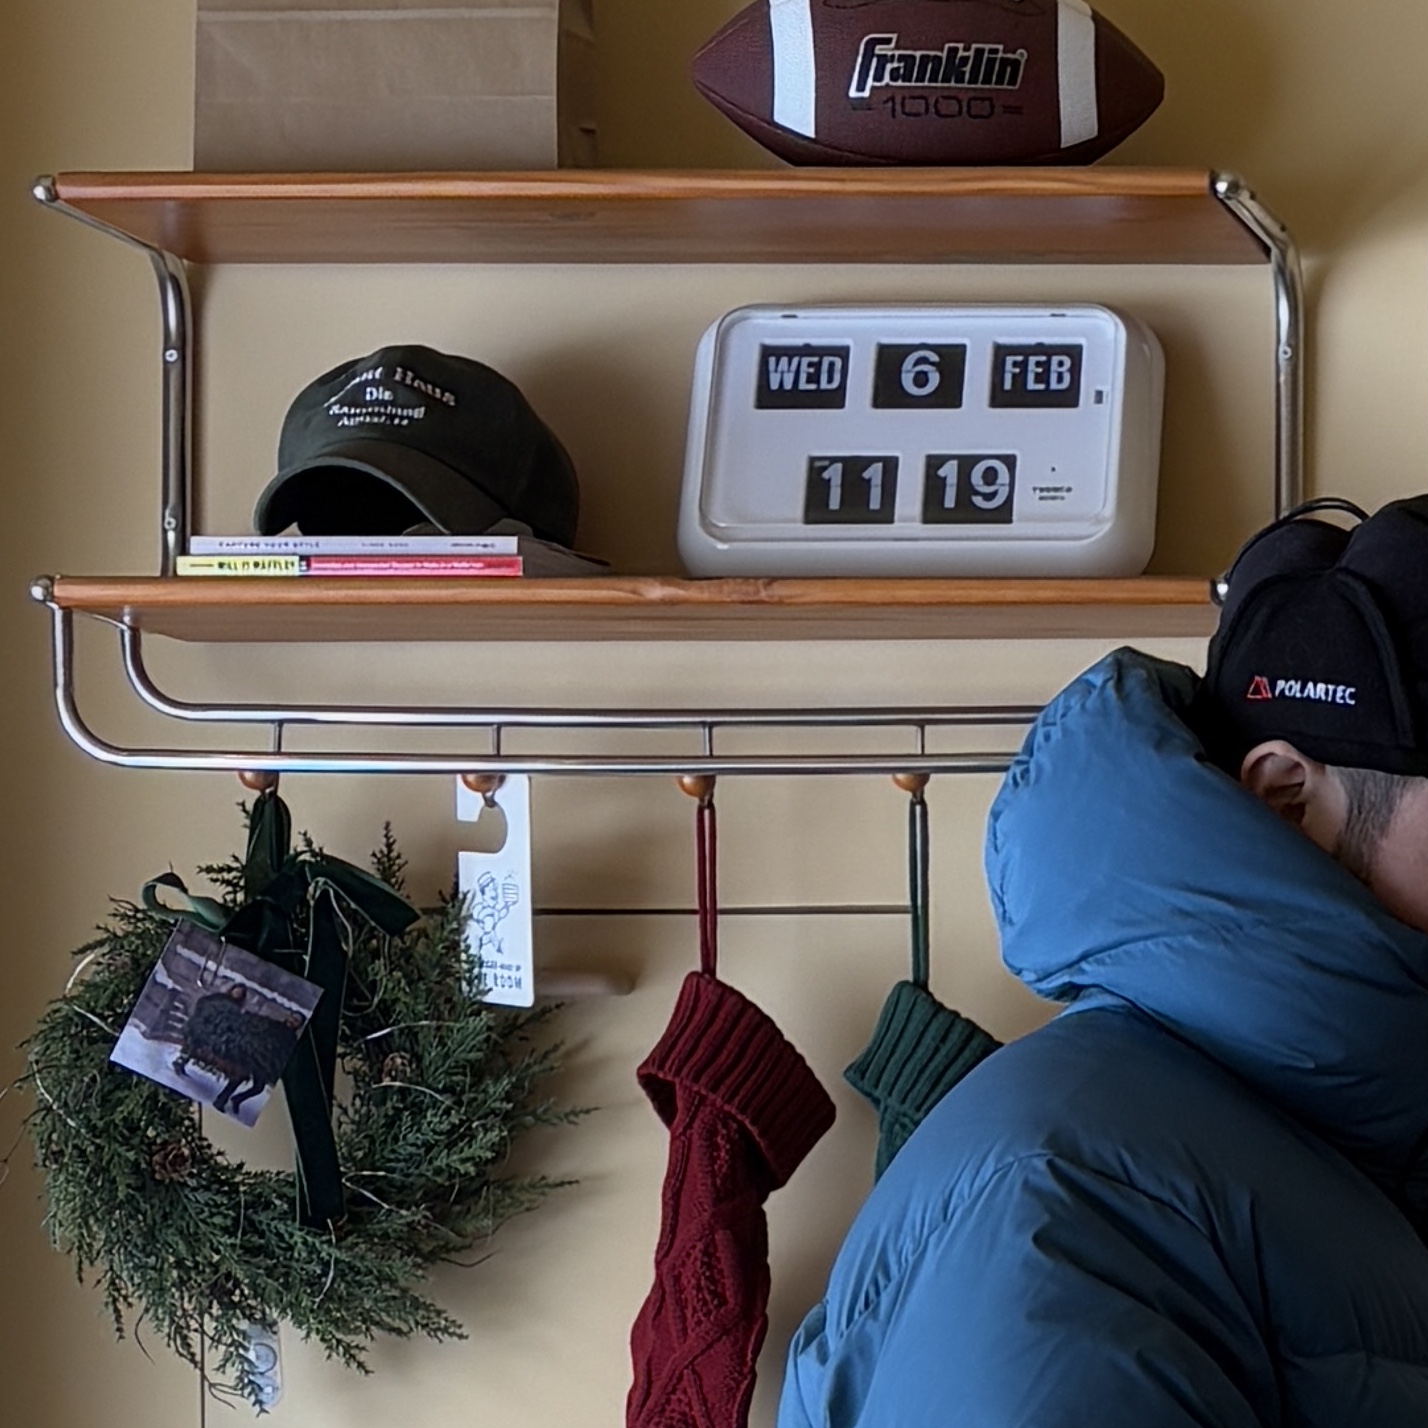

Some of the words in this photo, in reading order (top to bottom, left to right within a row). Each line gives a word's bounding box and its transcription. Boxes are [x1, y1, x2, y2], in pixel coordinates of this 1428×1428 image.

[767, 355, 842, 391] WED
[900, 350, 940, 396] 6
[1003, 354, 1072, 391] FEB
[821, 462, 882, 511] 11
[937, 459, 1010, 510] 19
[1275, 679, 1356, 705] POLARTEC
